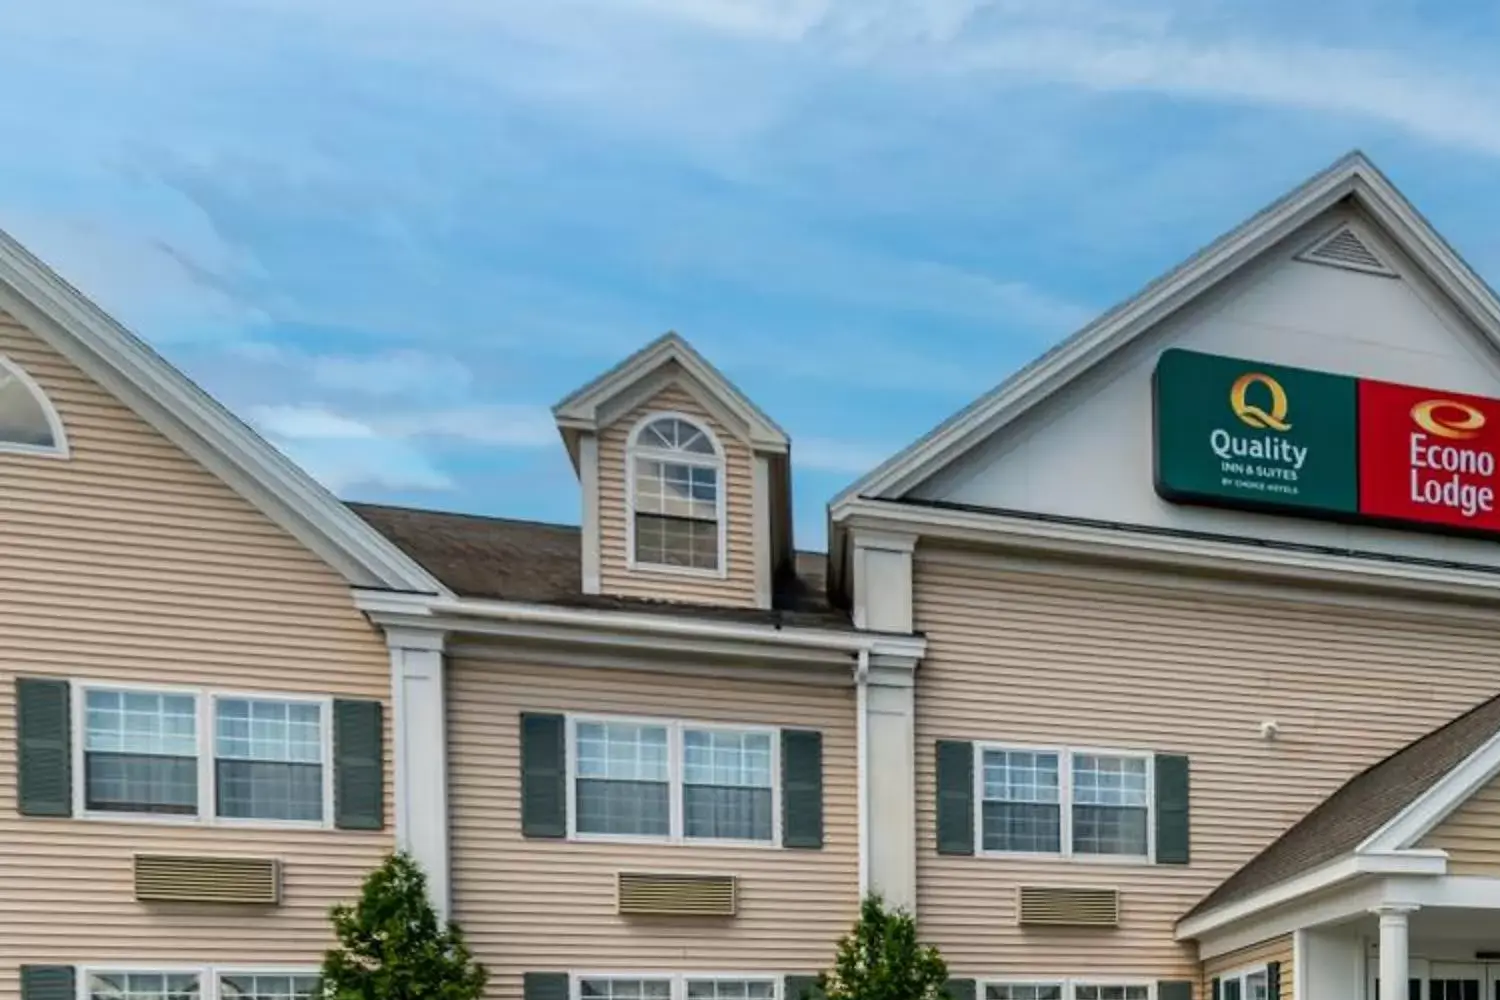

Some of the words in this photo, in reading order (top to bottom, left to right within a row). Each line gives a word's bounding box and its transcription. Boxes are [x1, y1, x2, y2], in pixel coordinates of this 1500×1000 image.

[1210, 428, 1307, 469] Quality
[1411, 432, 1494, 477] Econo
[1221, 461, 1244, 474] INN
[1256, 466, 1298, 481] SUITES
[1411, 468, 1494, 517] Lodge
